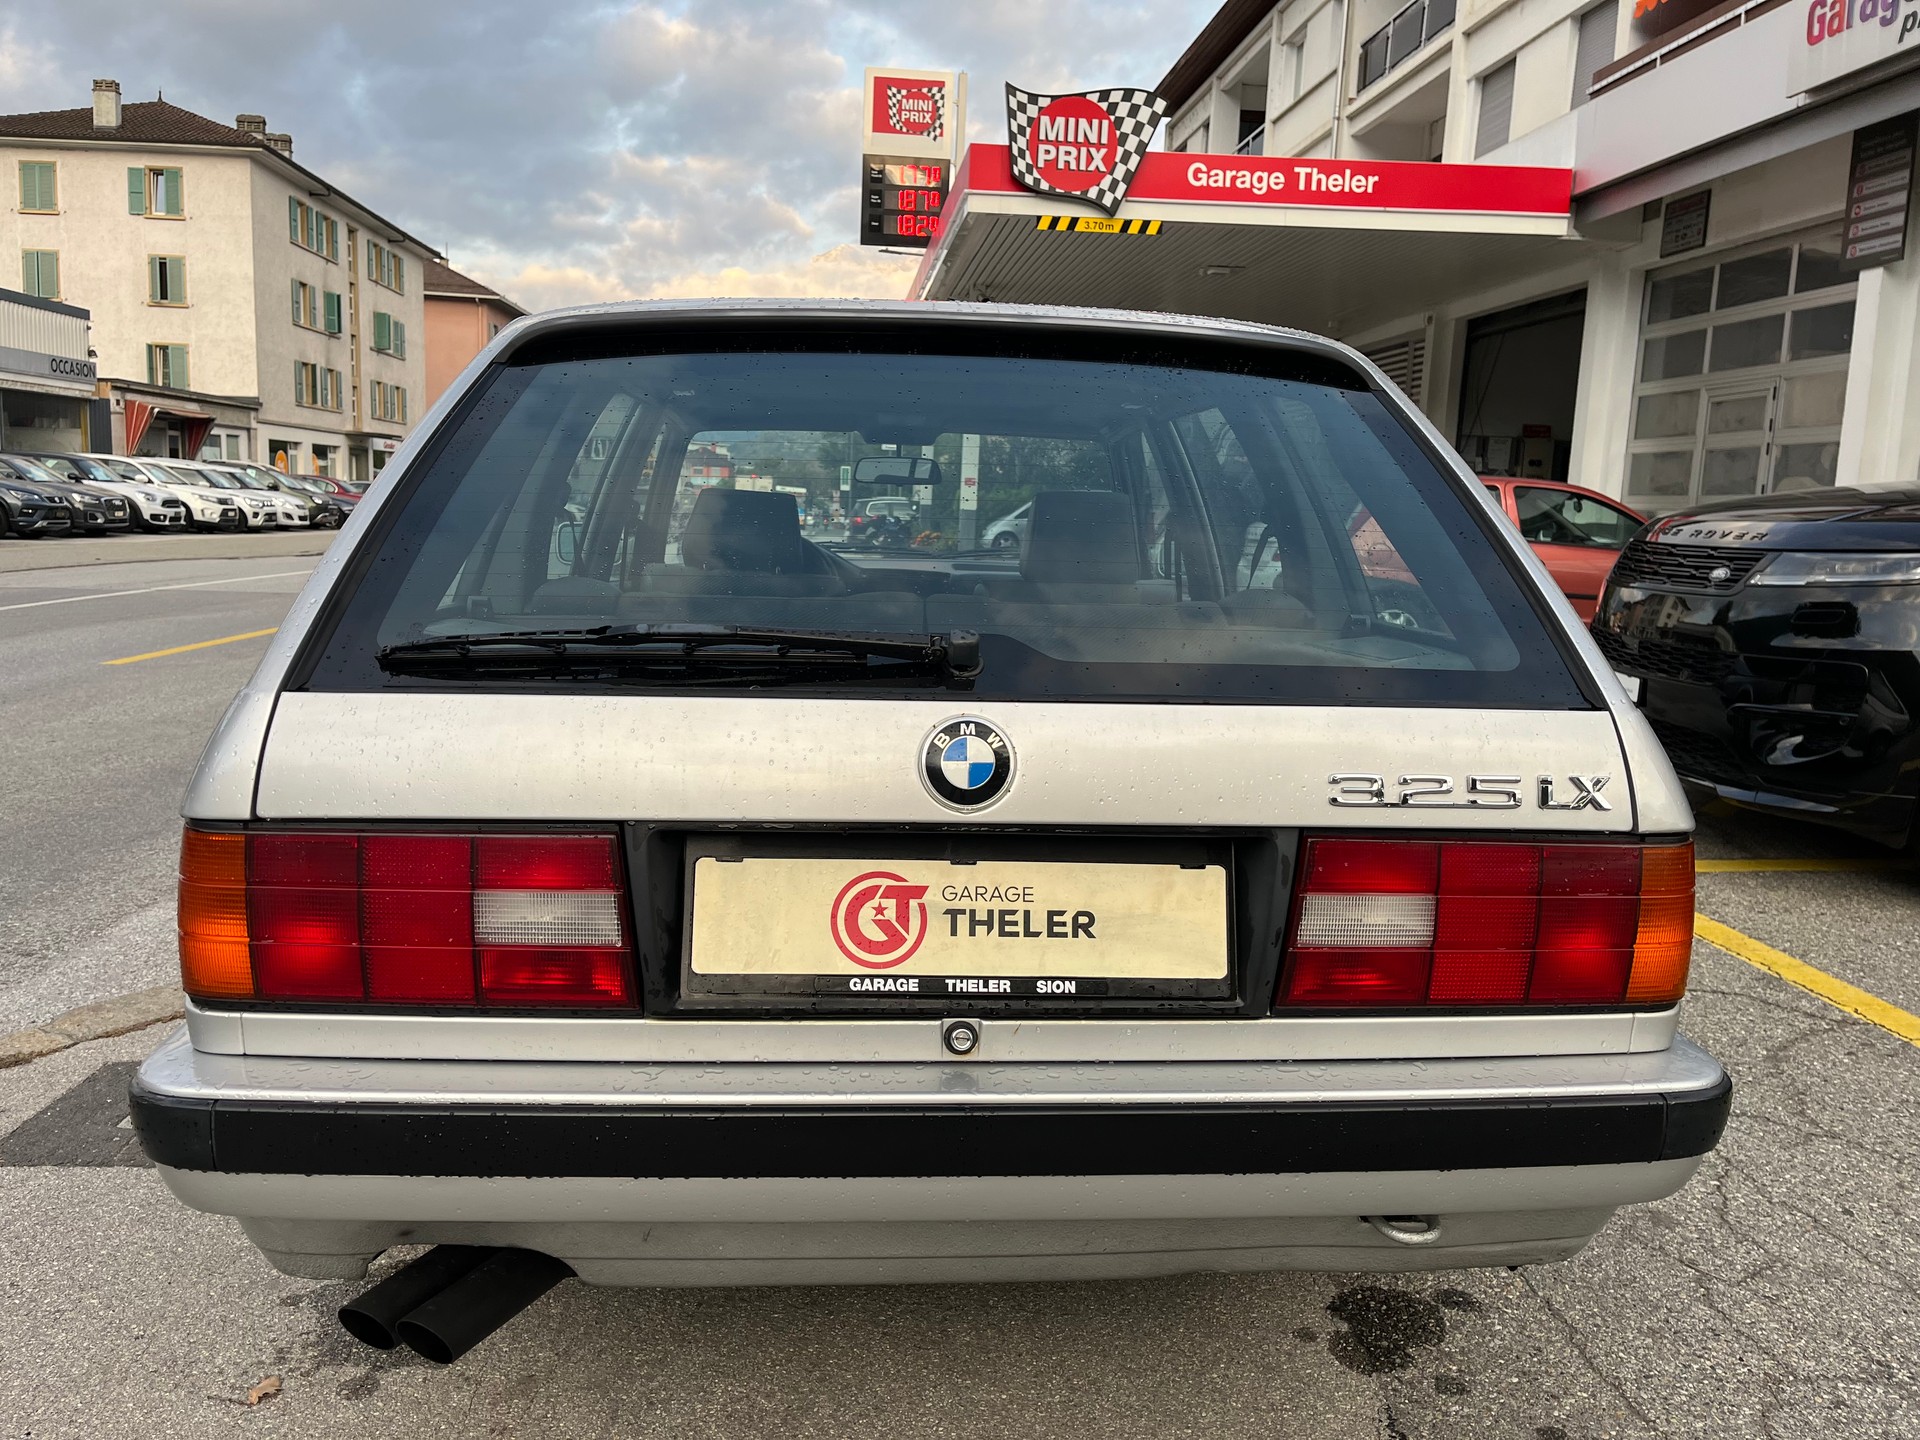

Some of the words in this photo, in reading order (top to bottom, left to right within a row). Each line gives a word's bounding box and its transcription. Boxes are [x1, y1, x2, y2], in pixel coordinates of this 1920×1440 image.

[1806, 0, 1914, 46] Garag
[900, 110, 932, 124] PRIX
[901, 98, 932, 111] MINI
[1038, 115, 1110, 145] MINI
[1036, 143, 1109, 173] PRIX
[1186, 161, 1286, 196] Garage
[1293, 166, 1380, 194] Theler
[51, 358, 96, 378] OCCASION
[1688, 529, 1769, 541] ROVER
[932, 722, 1005, 750] BMW
[1328, 773, 1522, 810] 325
[942, 885, 1035, 903] GARAGE
[942, 908, 1097, 939] THELER
[849, 978, 919, 992] GARAGE
[945, 979, 1012, 993] THELER
[1036, 980, 1077, 994] SION
